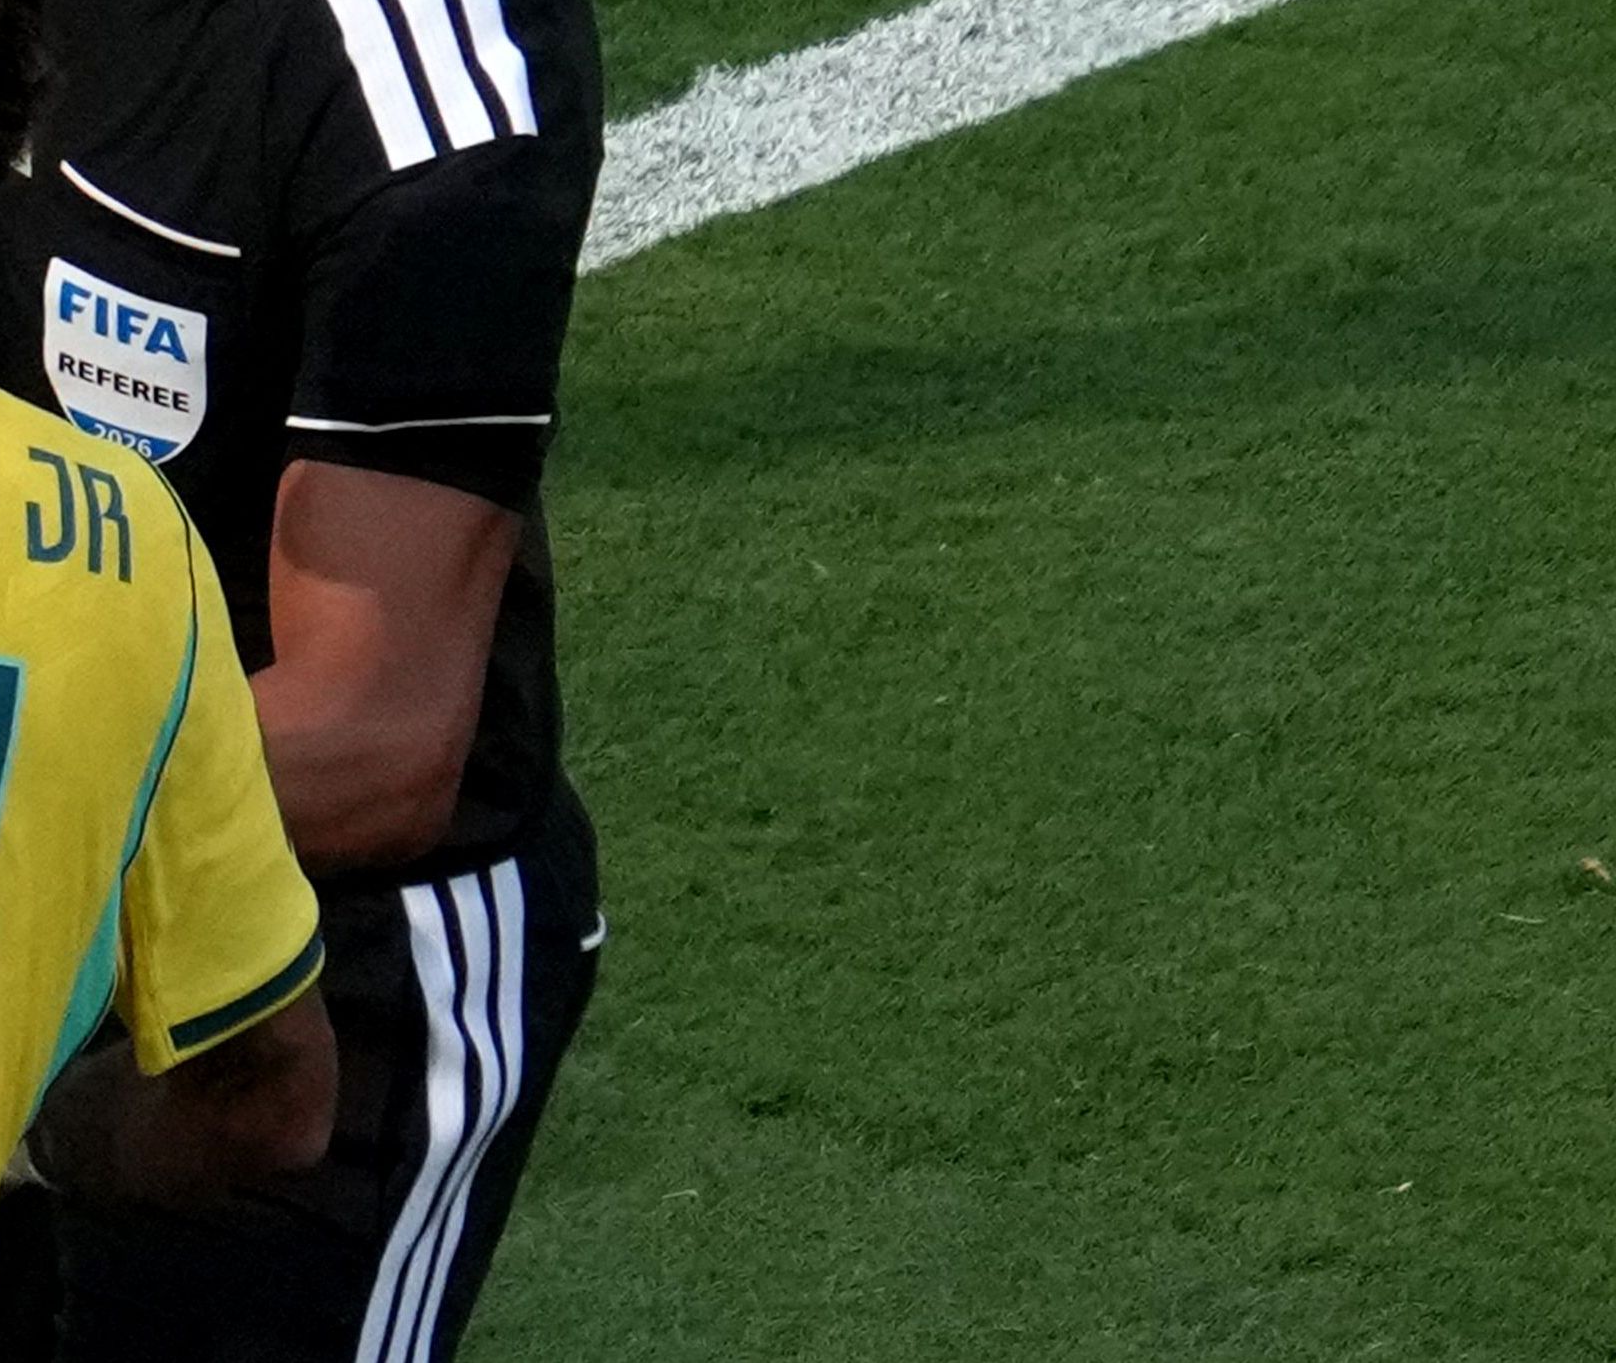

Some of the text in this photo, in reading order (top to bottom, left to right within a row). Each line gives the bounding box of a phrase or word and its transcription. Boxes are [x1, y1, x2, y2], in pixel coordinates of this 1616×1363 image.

[59, 279, 190, 365] FIFA
[58, 351, 190, 414] REFEREE
[25, 446, 133, 584] JR
